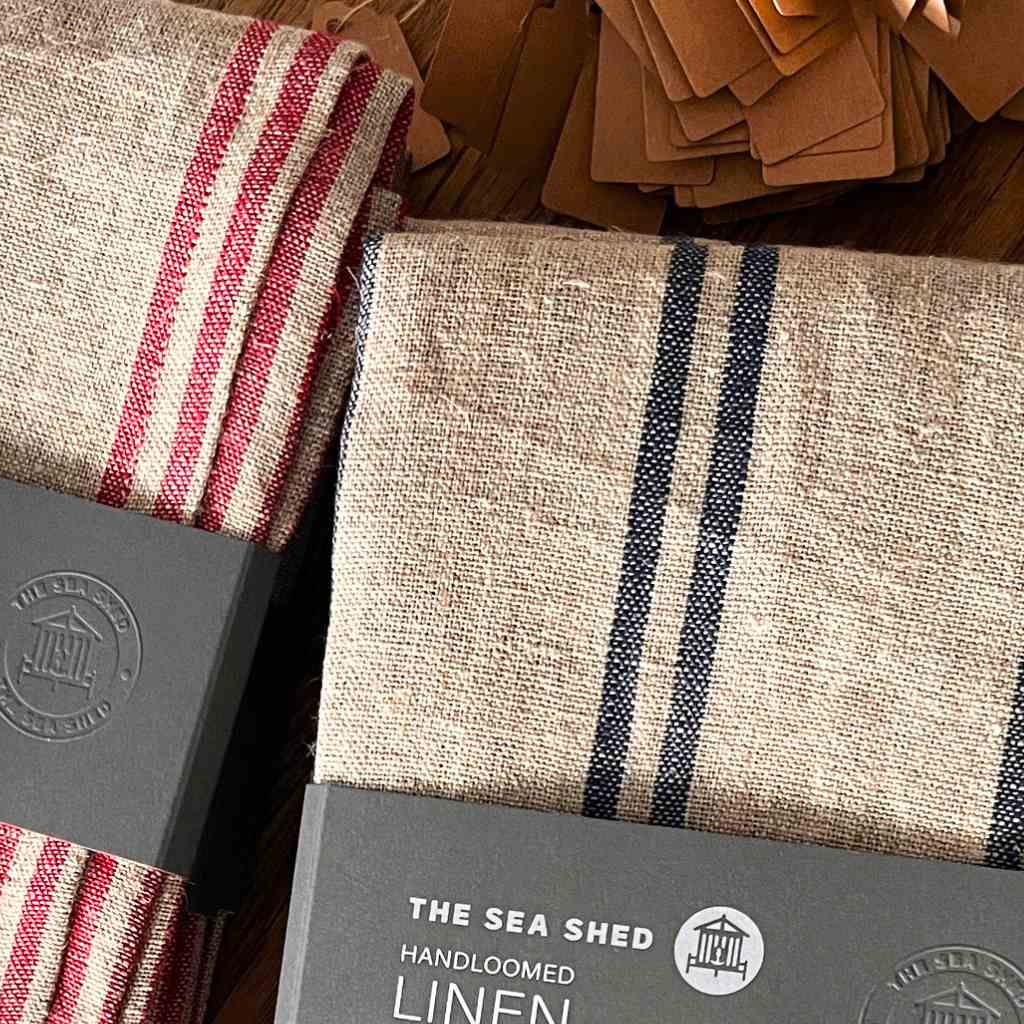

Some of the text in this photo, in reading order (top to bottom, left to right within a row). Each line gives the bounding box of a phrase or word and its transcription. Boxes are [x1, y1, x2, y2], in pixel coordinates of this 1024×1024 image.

[409, 896, 654, 951] THE SEA SHED
[400, 943, 576, 986] HANDLOOMED
